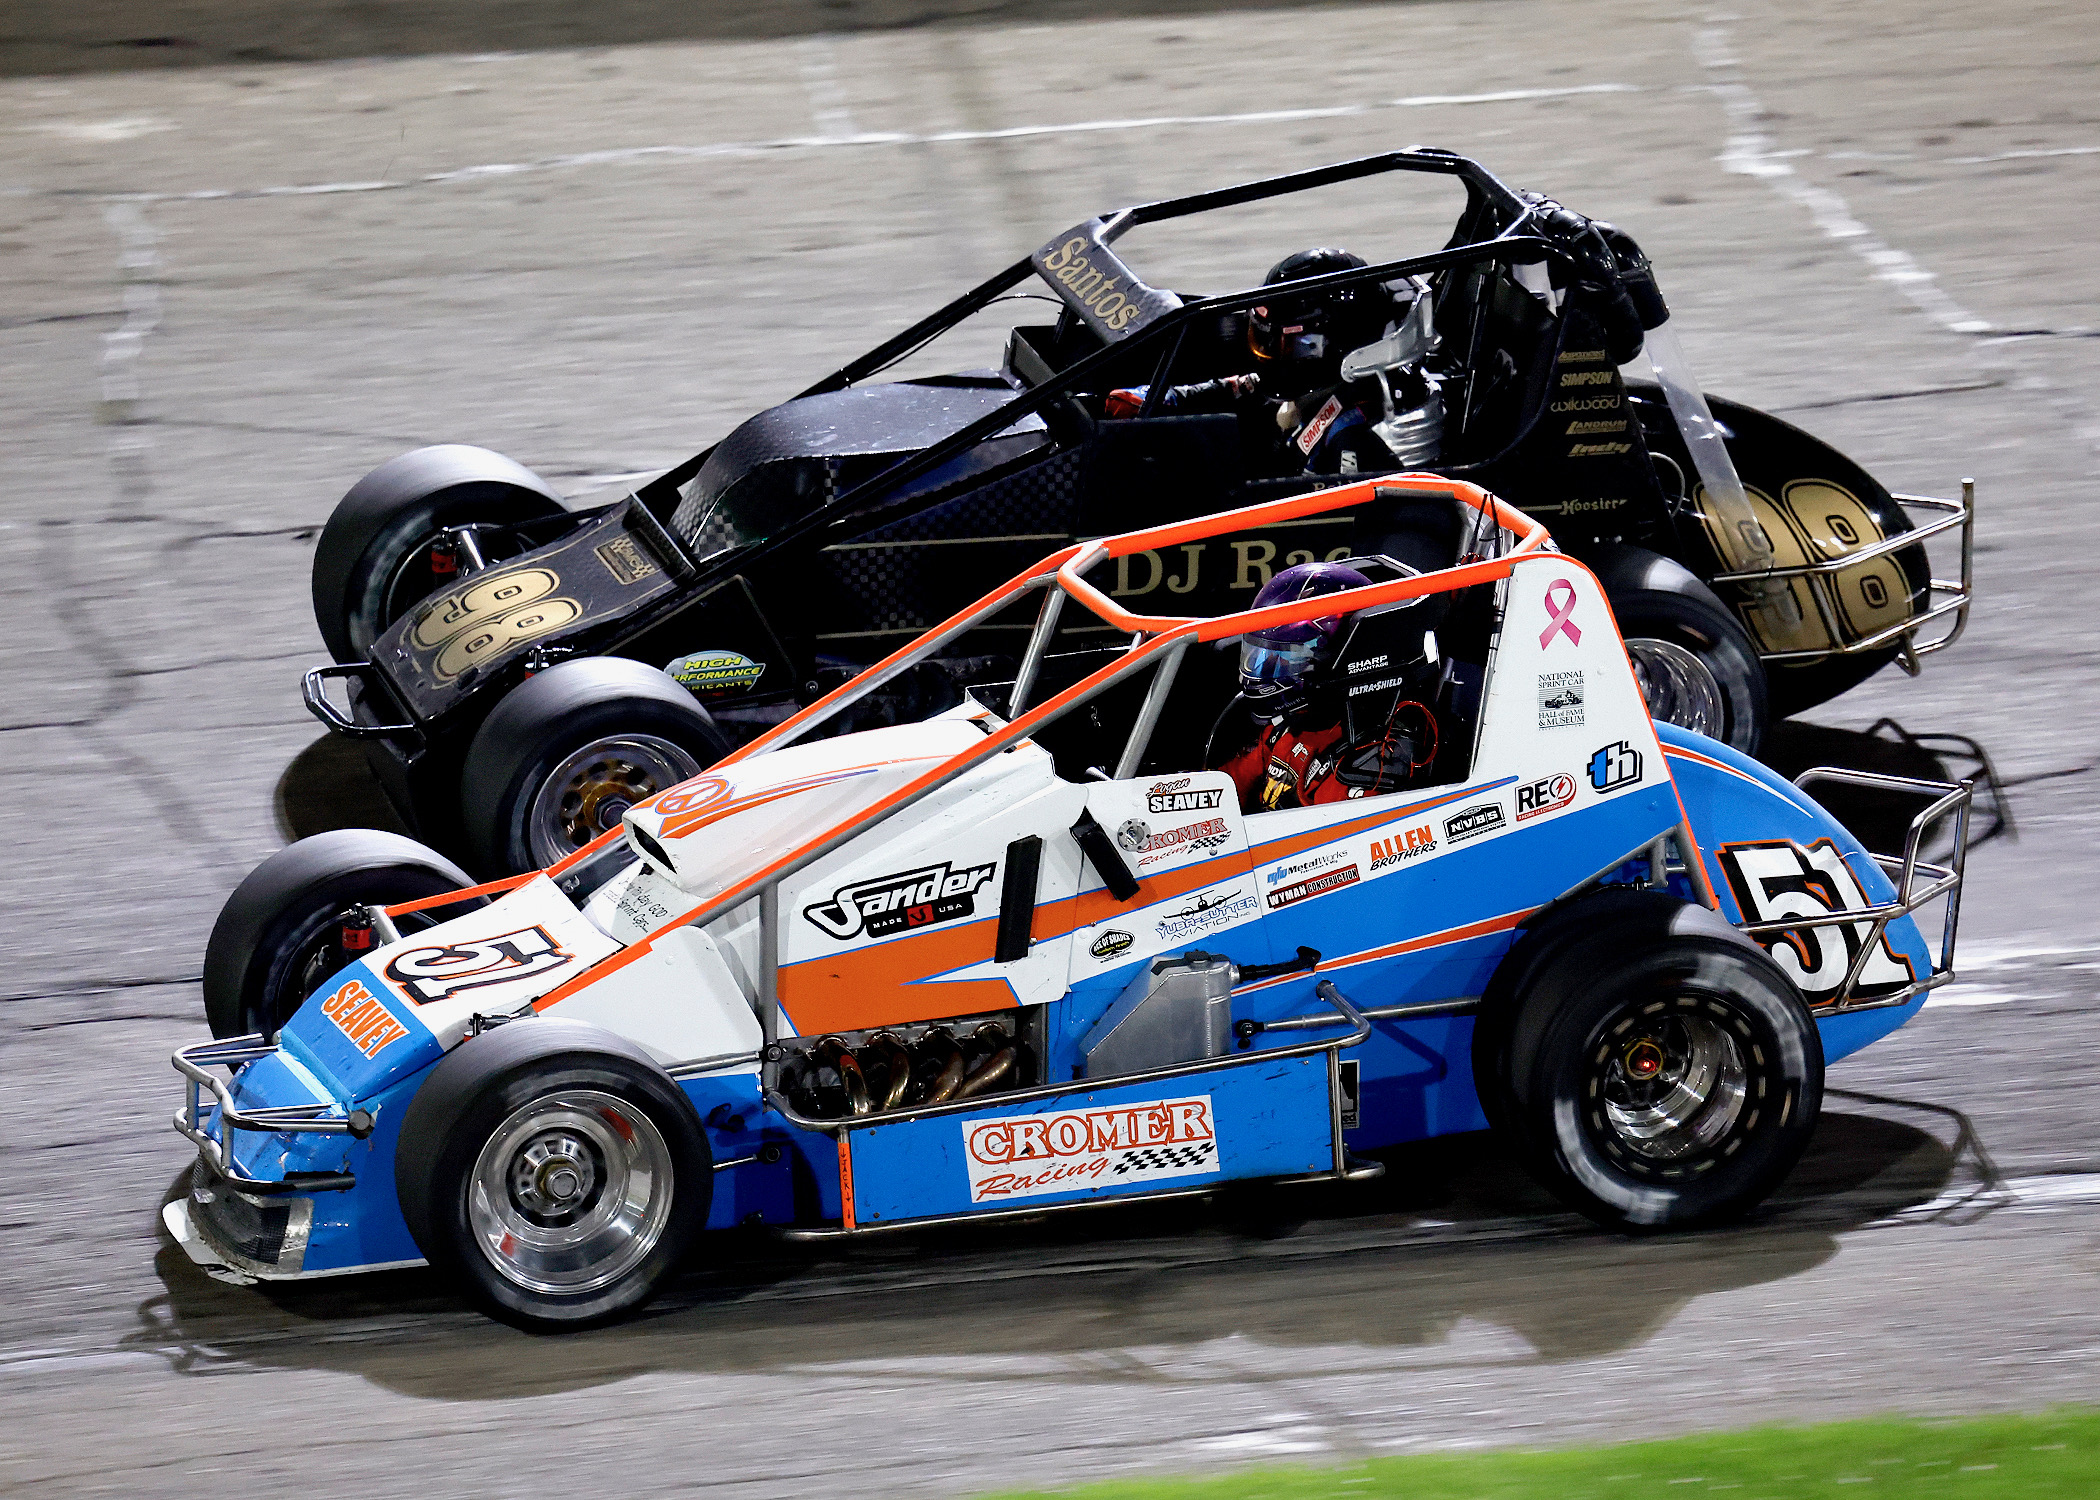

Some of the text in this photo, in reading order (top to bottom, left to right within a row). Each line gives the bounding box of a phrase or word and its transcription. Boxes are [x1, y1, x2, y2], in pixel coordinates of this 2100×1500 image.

[1042, 236, 1140, 331] Santos
[1560, 371, 1613, 386] SIMPSON
[1302, 401, 1337, 449] SIMPSON
[1110, 544, 1206, 597] DJ
[410, 568, 584, 682] 98
[672, 667, 761, 682] ERFORMANCE
[683, 656, 743, 671] HIGH
[1347, 655, 1388, 670] SHARP
[1348, 661, 1389, 675] ADVANTAGE
[1538, 670, 1585, 682] NATIONAL
[1538, 678, 1585, 689] SPRINT CAR
[1538, 711, 1557, 719] HALL
[1566, 708, 1585, 716] FAME
[1538, 714, 1585, 726] & MUSEUM
[1146, 778, 1191, 799] Logan
[1150, 790, 1221, 812] SEAVEY
[1137, 817, 1228, 853] ROMER
[1370, 825, 1433, 863] ALLEN
[1136, 845, 1189, 868] Racing
[1370, 840, 1438, 871] BROTHERS
[805, 864, 994, 938] Sander
[1268, 868, 1358, 906] WYMAN CONSTRUCTION
[873, 903, 963, 929] MADE USA
[1154, 896, 1258, 940] YUBA-SUTTER
[1170, 911, 1239, 941] AVIATION
[1714, 837, 1918, 1007] 51
[383, 923, 576, 1006] 51
[320, 979, 411, 1061] SEAVEY
[969, 1100, 1213, 1165] CROMER
[841, 1159, 851, 1191] JACK
[976, 1156, 1111, 1201] Racing
